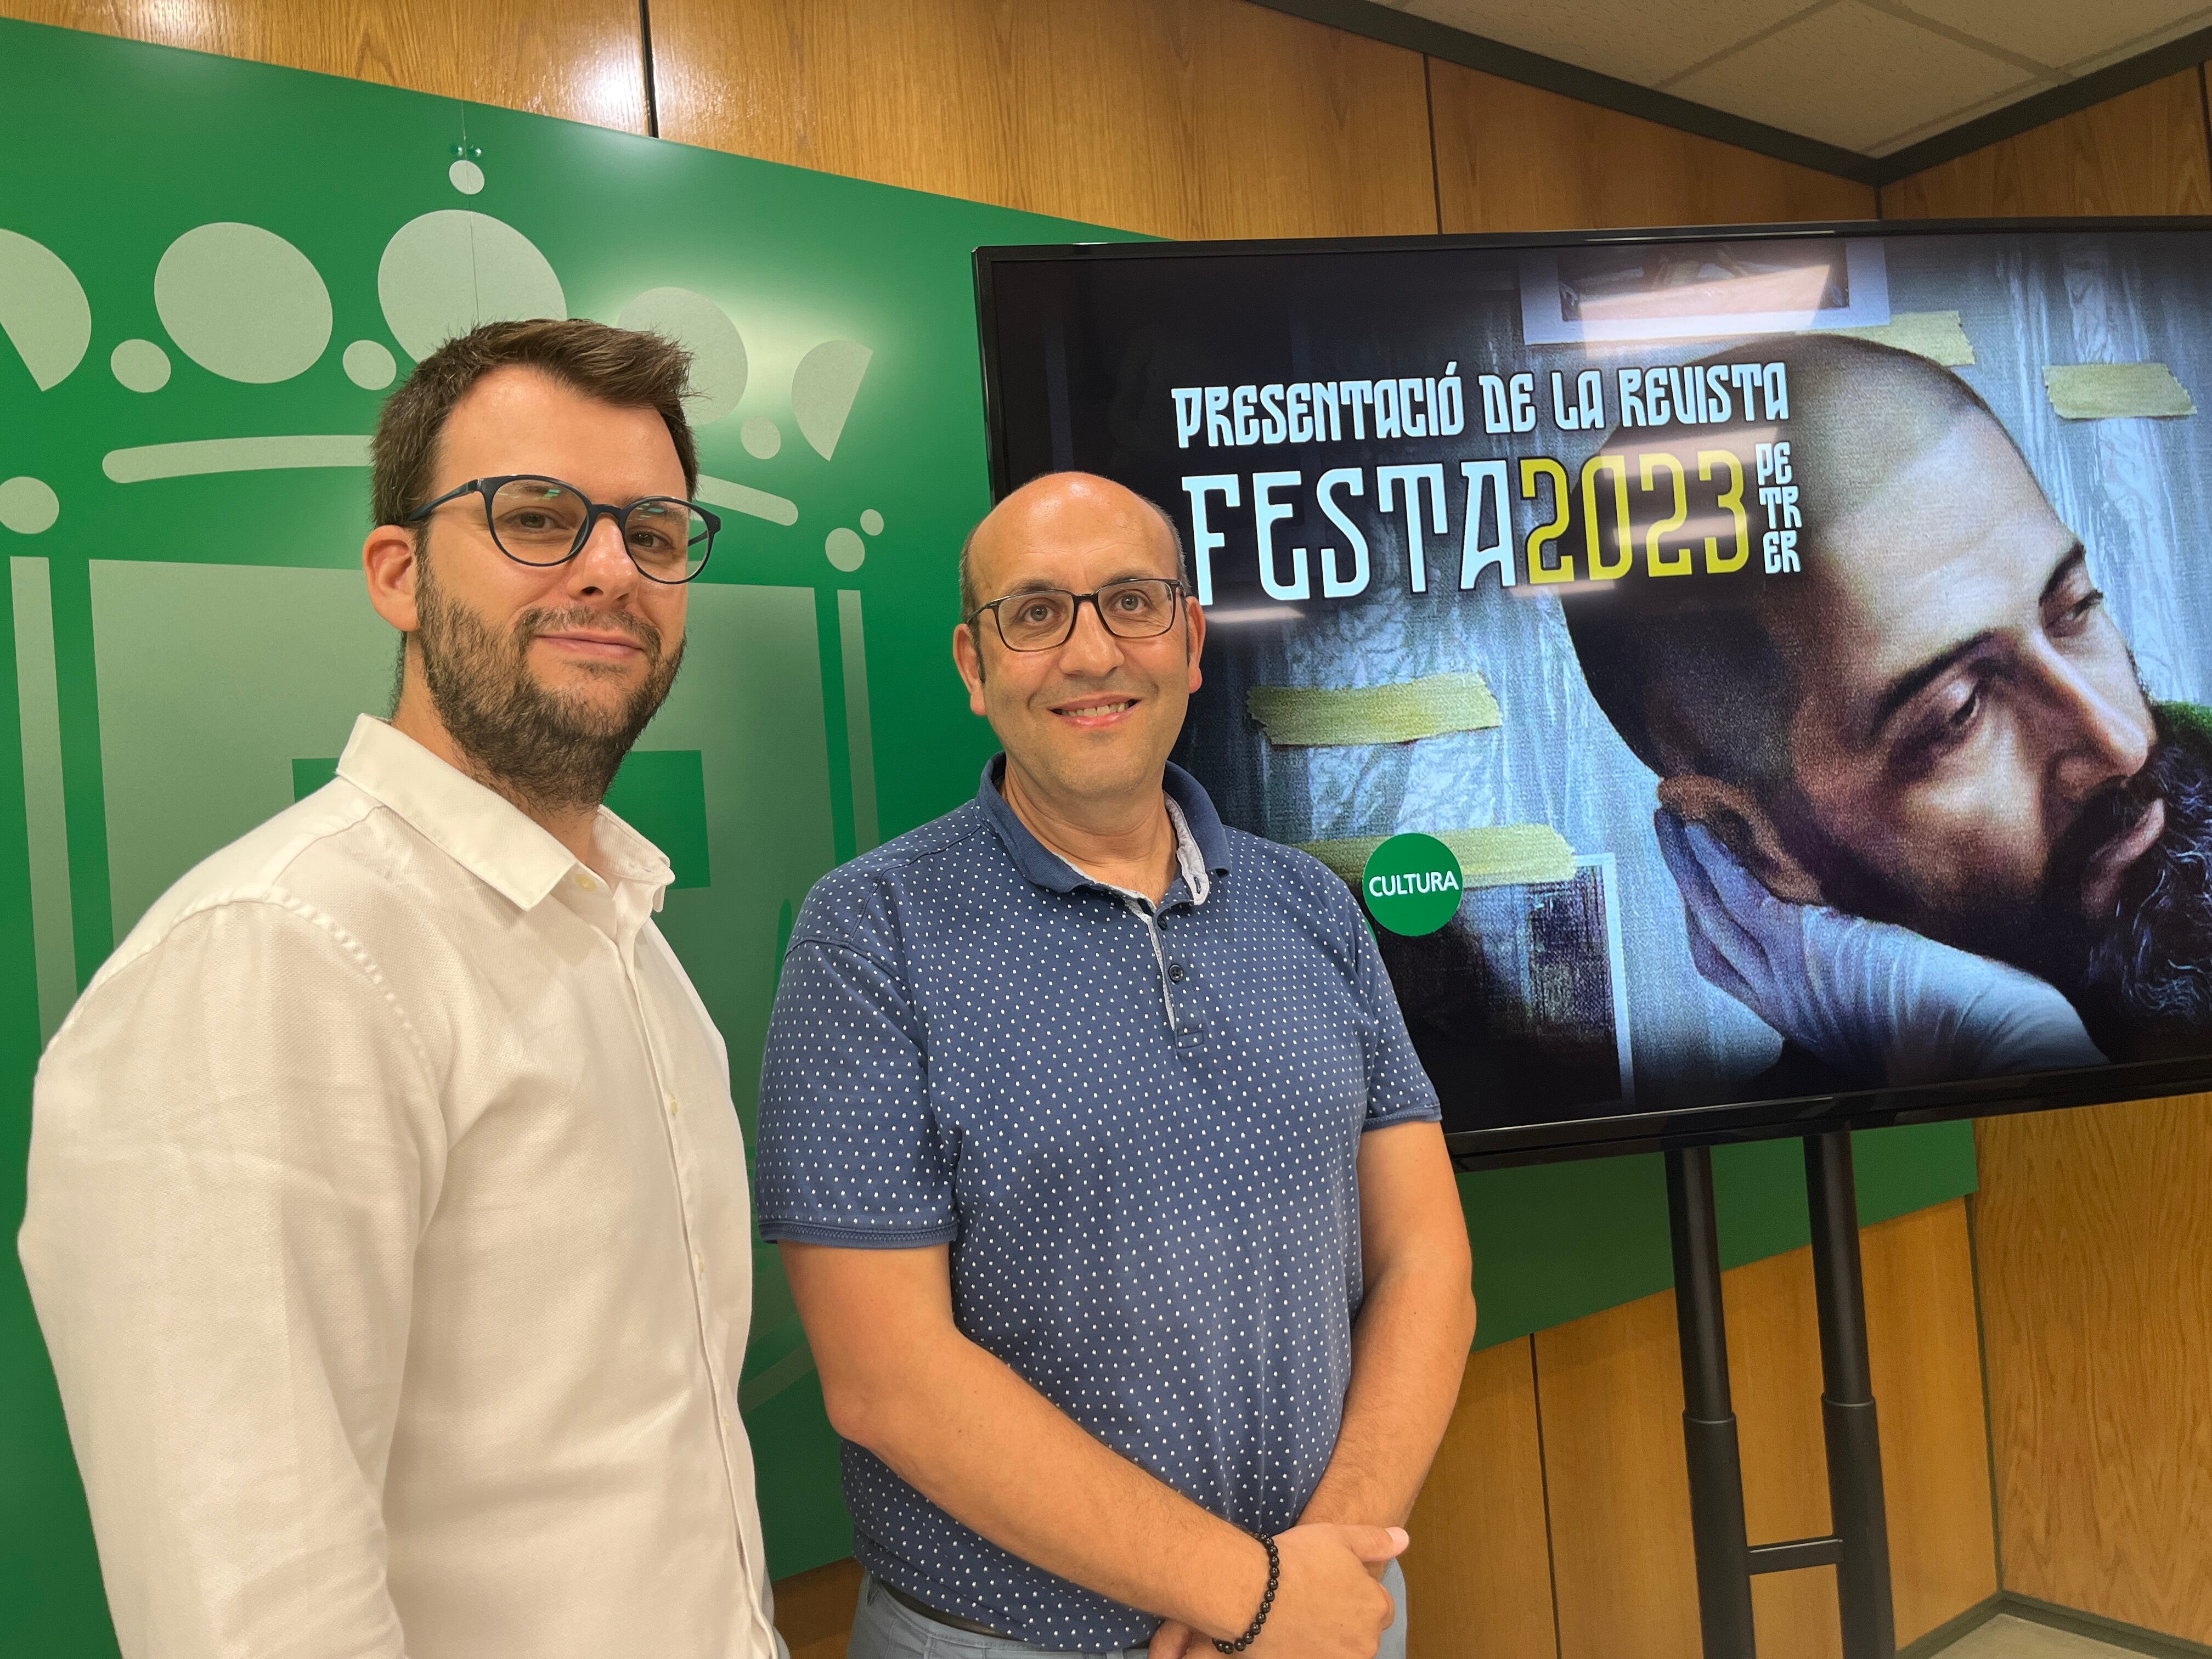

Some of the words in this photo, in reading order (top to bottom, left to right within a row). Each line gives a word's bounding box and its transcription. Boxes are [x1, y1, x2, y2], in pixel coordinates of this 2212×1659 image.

[1170, 361, 1465, 449] PRESENTACIÓ
[1478, 374, 1536, 434] DE
[1551, 370, 1605, 430] LA
[1618, 362, 1789, 427] REVISTA
[1368, 870, 1460, 898] CULTURA
